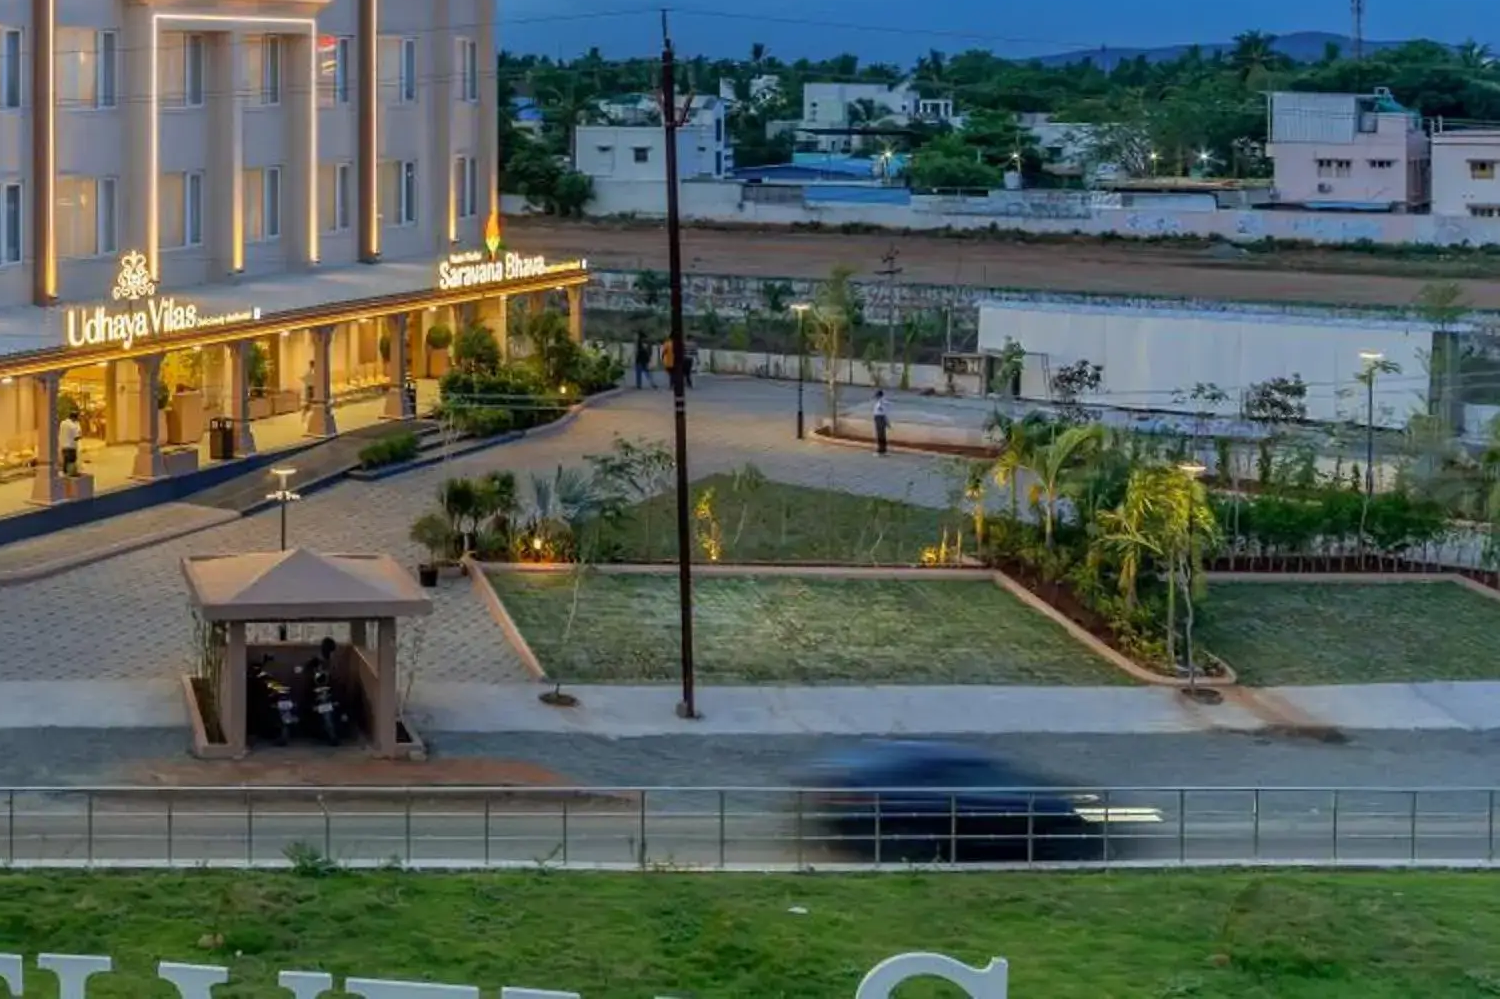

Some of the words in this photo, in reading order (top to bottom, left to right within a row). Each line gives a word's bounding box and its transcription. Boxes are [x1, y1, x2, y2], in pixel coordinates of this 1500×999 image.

[439, 260, 503, 290] Saravana
[505, 252, 545, 280] Bhava
[67, 306, 148, 349] Udhaya
[148, 297, 197, 334] Vilas
